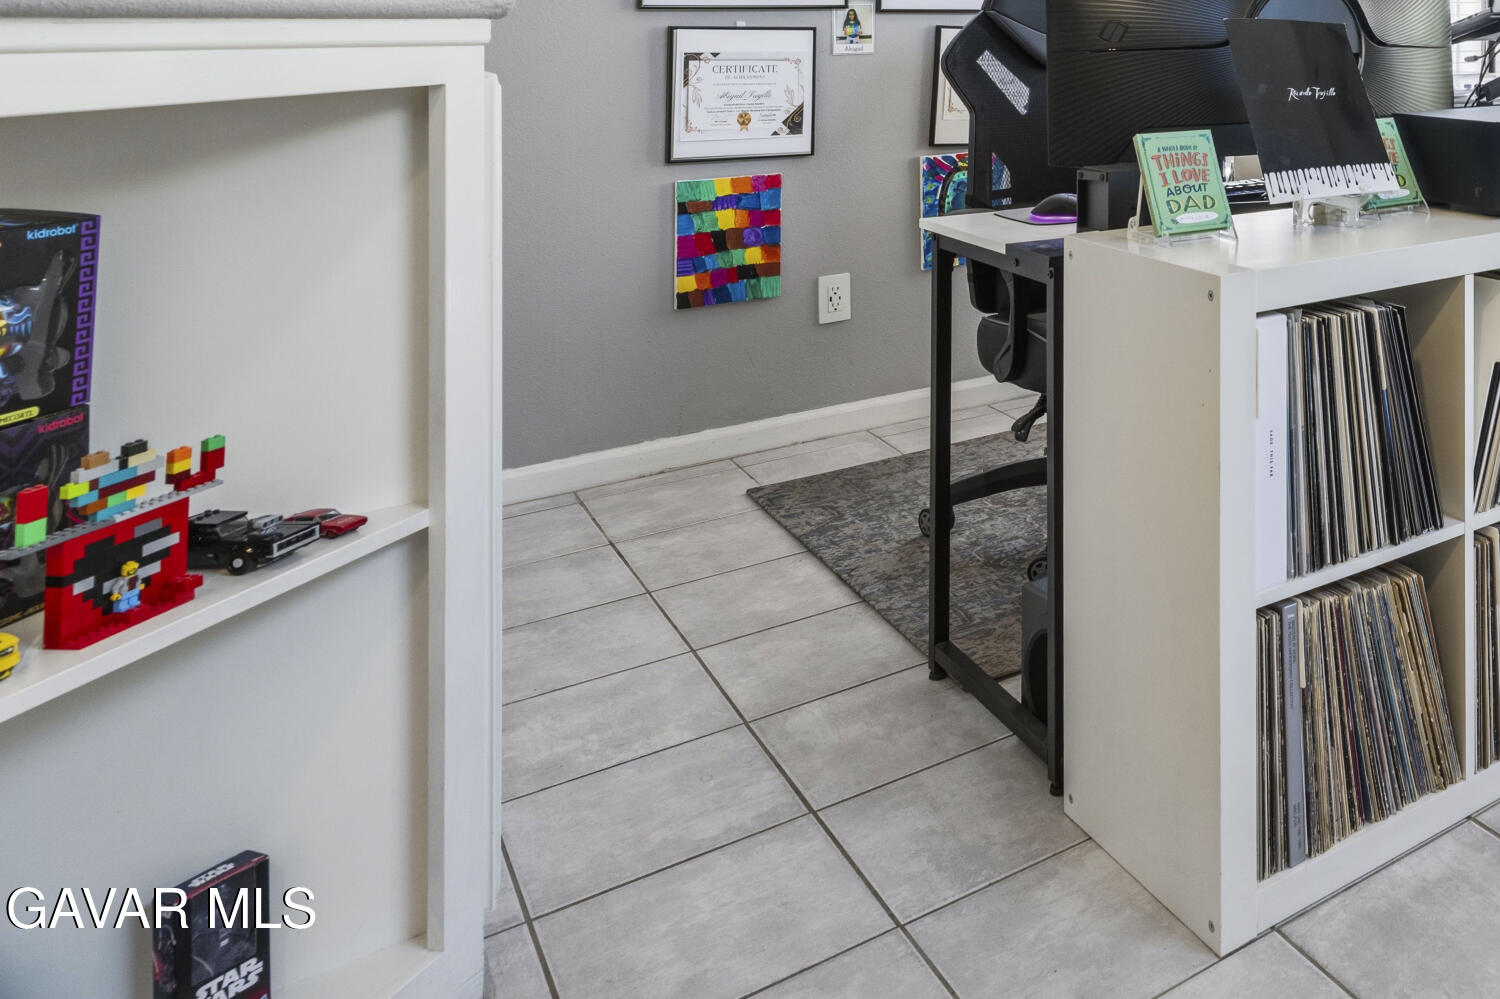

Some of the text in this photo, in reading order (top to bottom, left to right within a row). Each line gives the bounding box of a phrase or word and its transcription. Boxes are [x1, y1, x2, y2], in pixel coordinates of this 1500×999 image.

[712, 64, 779, 74] CERTIFICATE
[1150, 152, 1209, 172] THINGS
[1158, 167, 1211, 188] I LOVE
[1166, 182, 1209, 198] ABOUT
[1166, 194, 1216, 215] DAD
[26, 223, 79, 240] kidrobot
[38, 412, 84, 434] kidrobot
[195, 957, 264, 999] STAR
[209, 967, 264, 999] ARS
